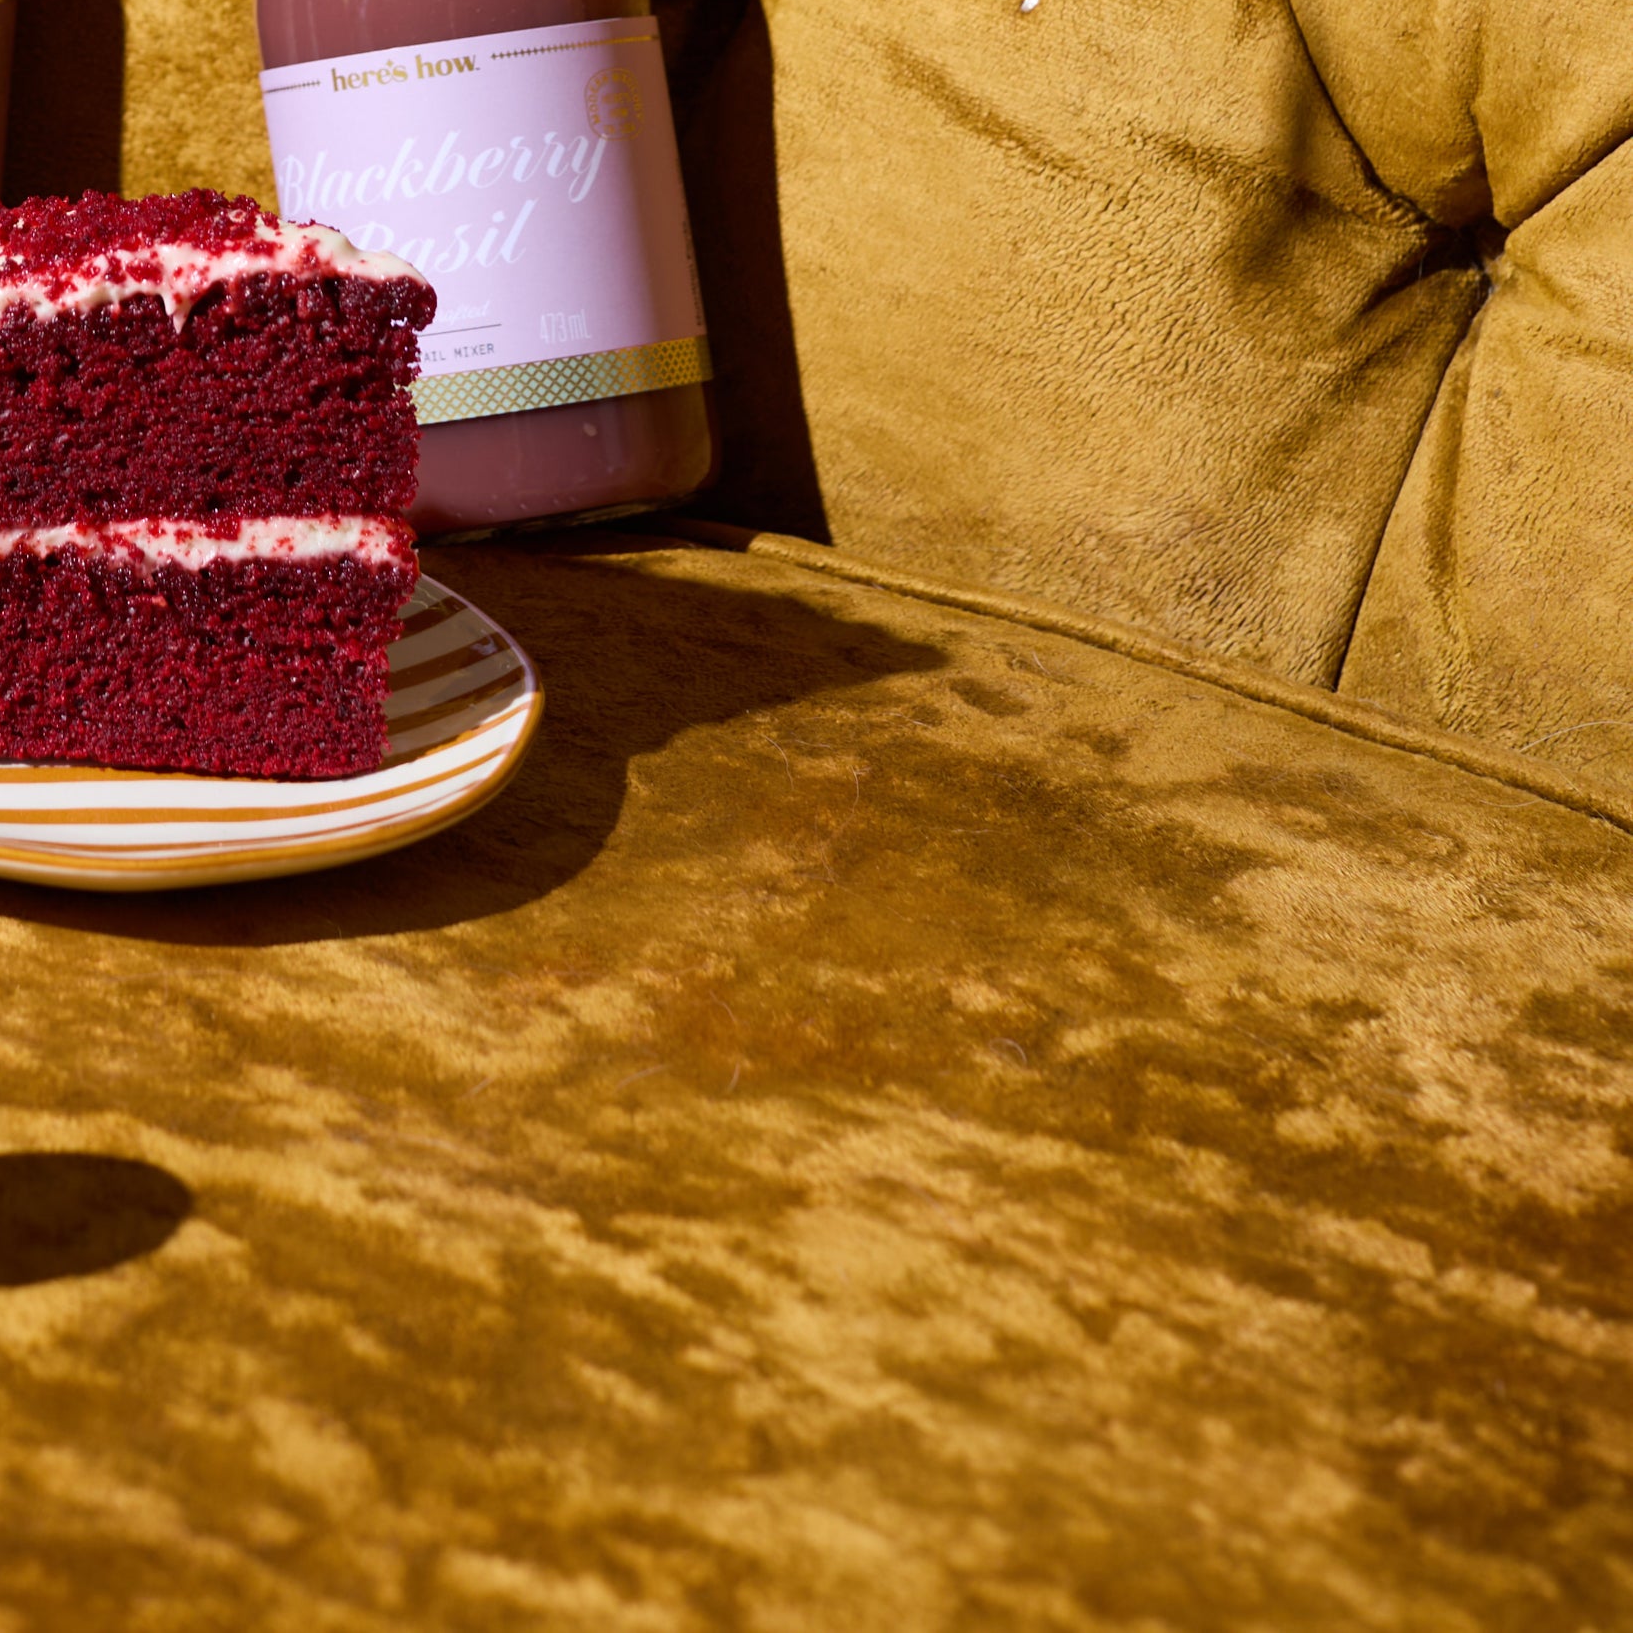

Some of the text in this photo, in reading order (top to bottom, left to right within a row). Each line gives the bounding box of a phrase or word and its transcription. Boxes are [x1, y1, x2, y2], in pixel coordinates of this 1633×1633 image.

[331, 59, 409, 93] here's
[280, 130, 608, 217] Blackberry
[453, 342, 495, 359] MIXER
